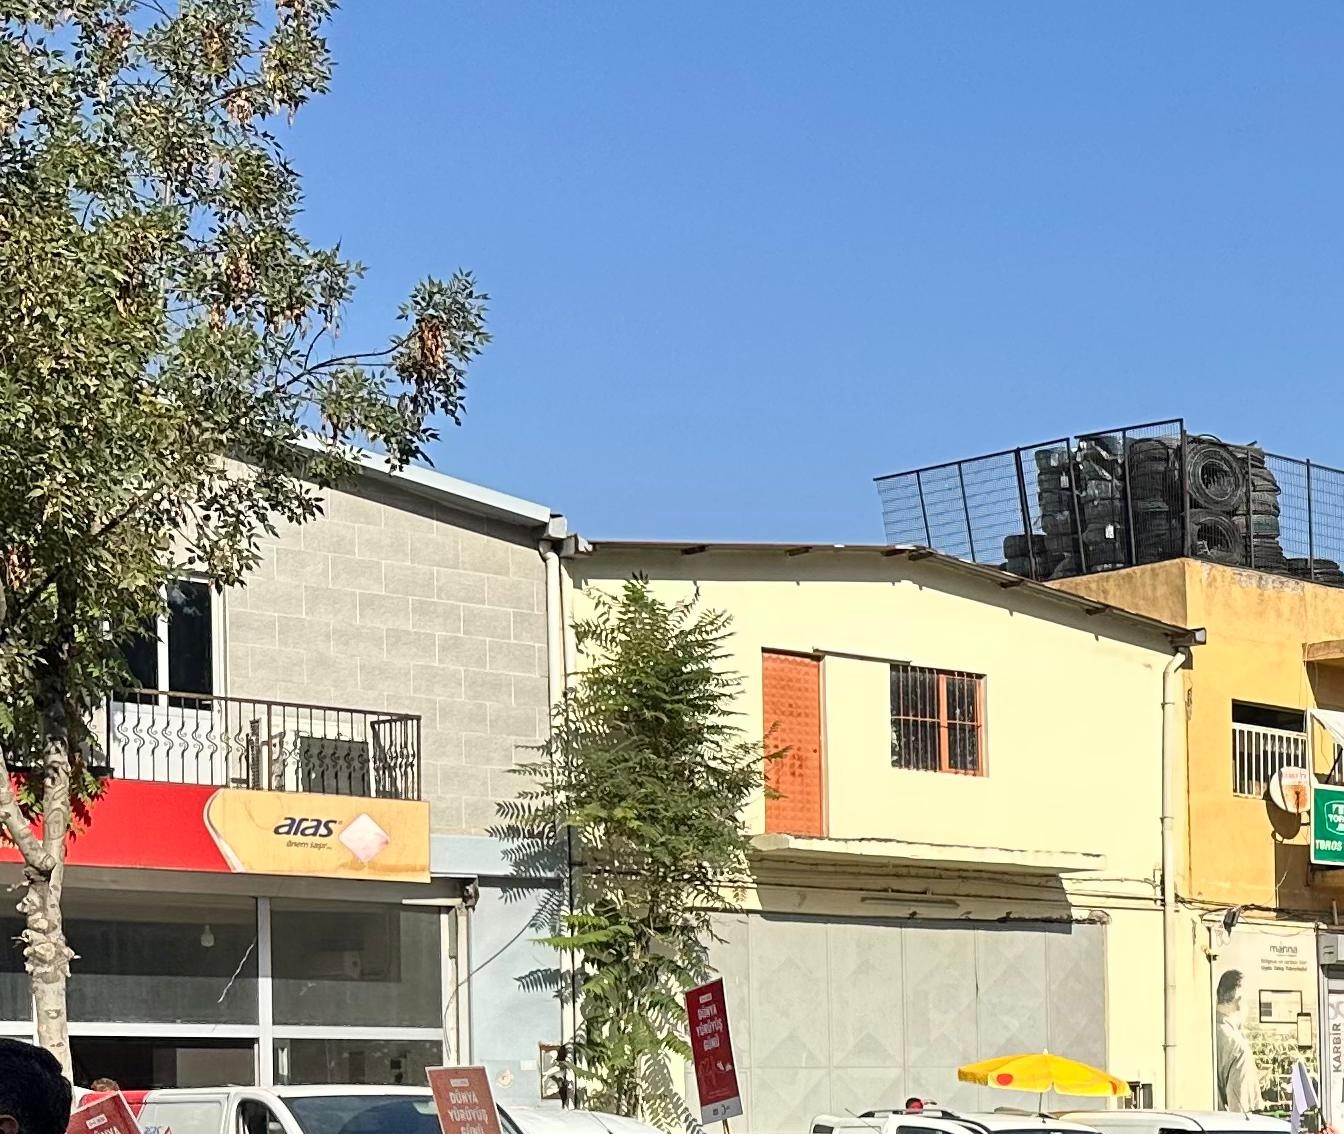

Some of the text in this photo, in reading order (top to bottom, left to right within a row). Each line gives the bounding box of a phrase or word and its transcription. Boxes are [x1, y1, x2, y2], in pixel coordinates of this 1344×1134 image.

[274, 817, 337, 838] aras
[1316, 839, 1343, 851] TOROS
[1329, 1022, 1342, 1073] KARBİR
[449, 1089, 479, 1105] DÜNYA
[447, 1106, 489, 1125] YÜRÜYÜŞ
